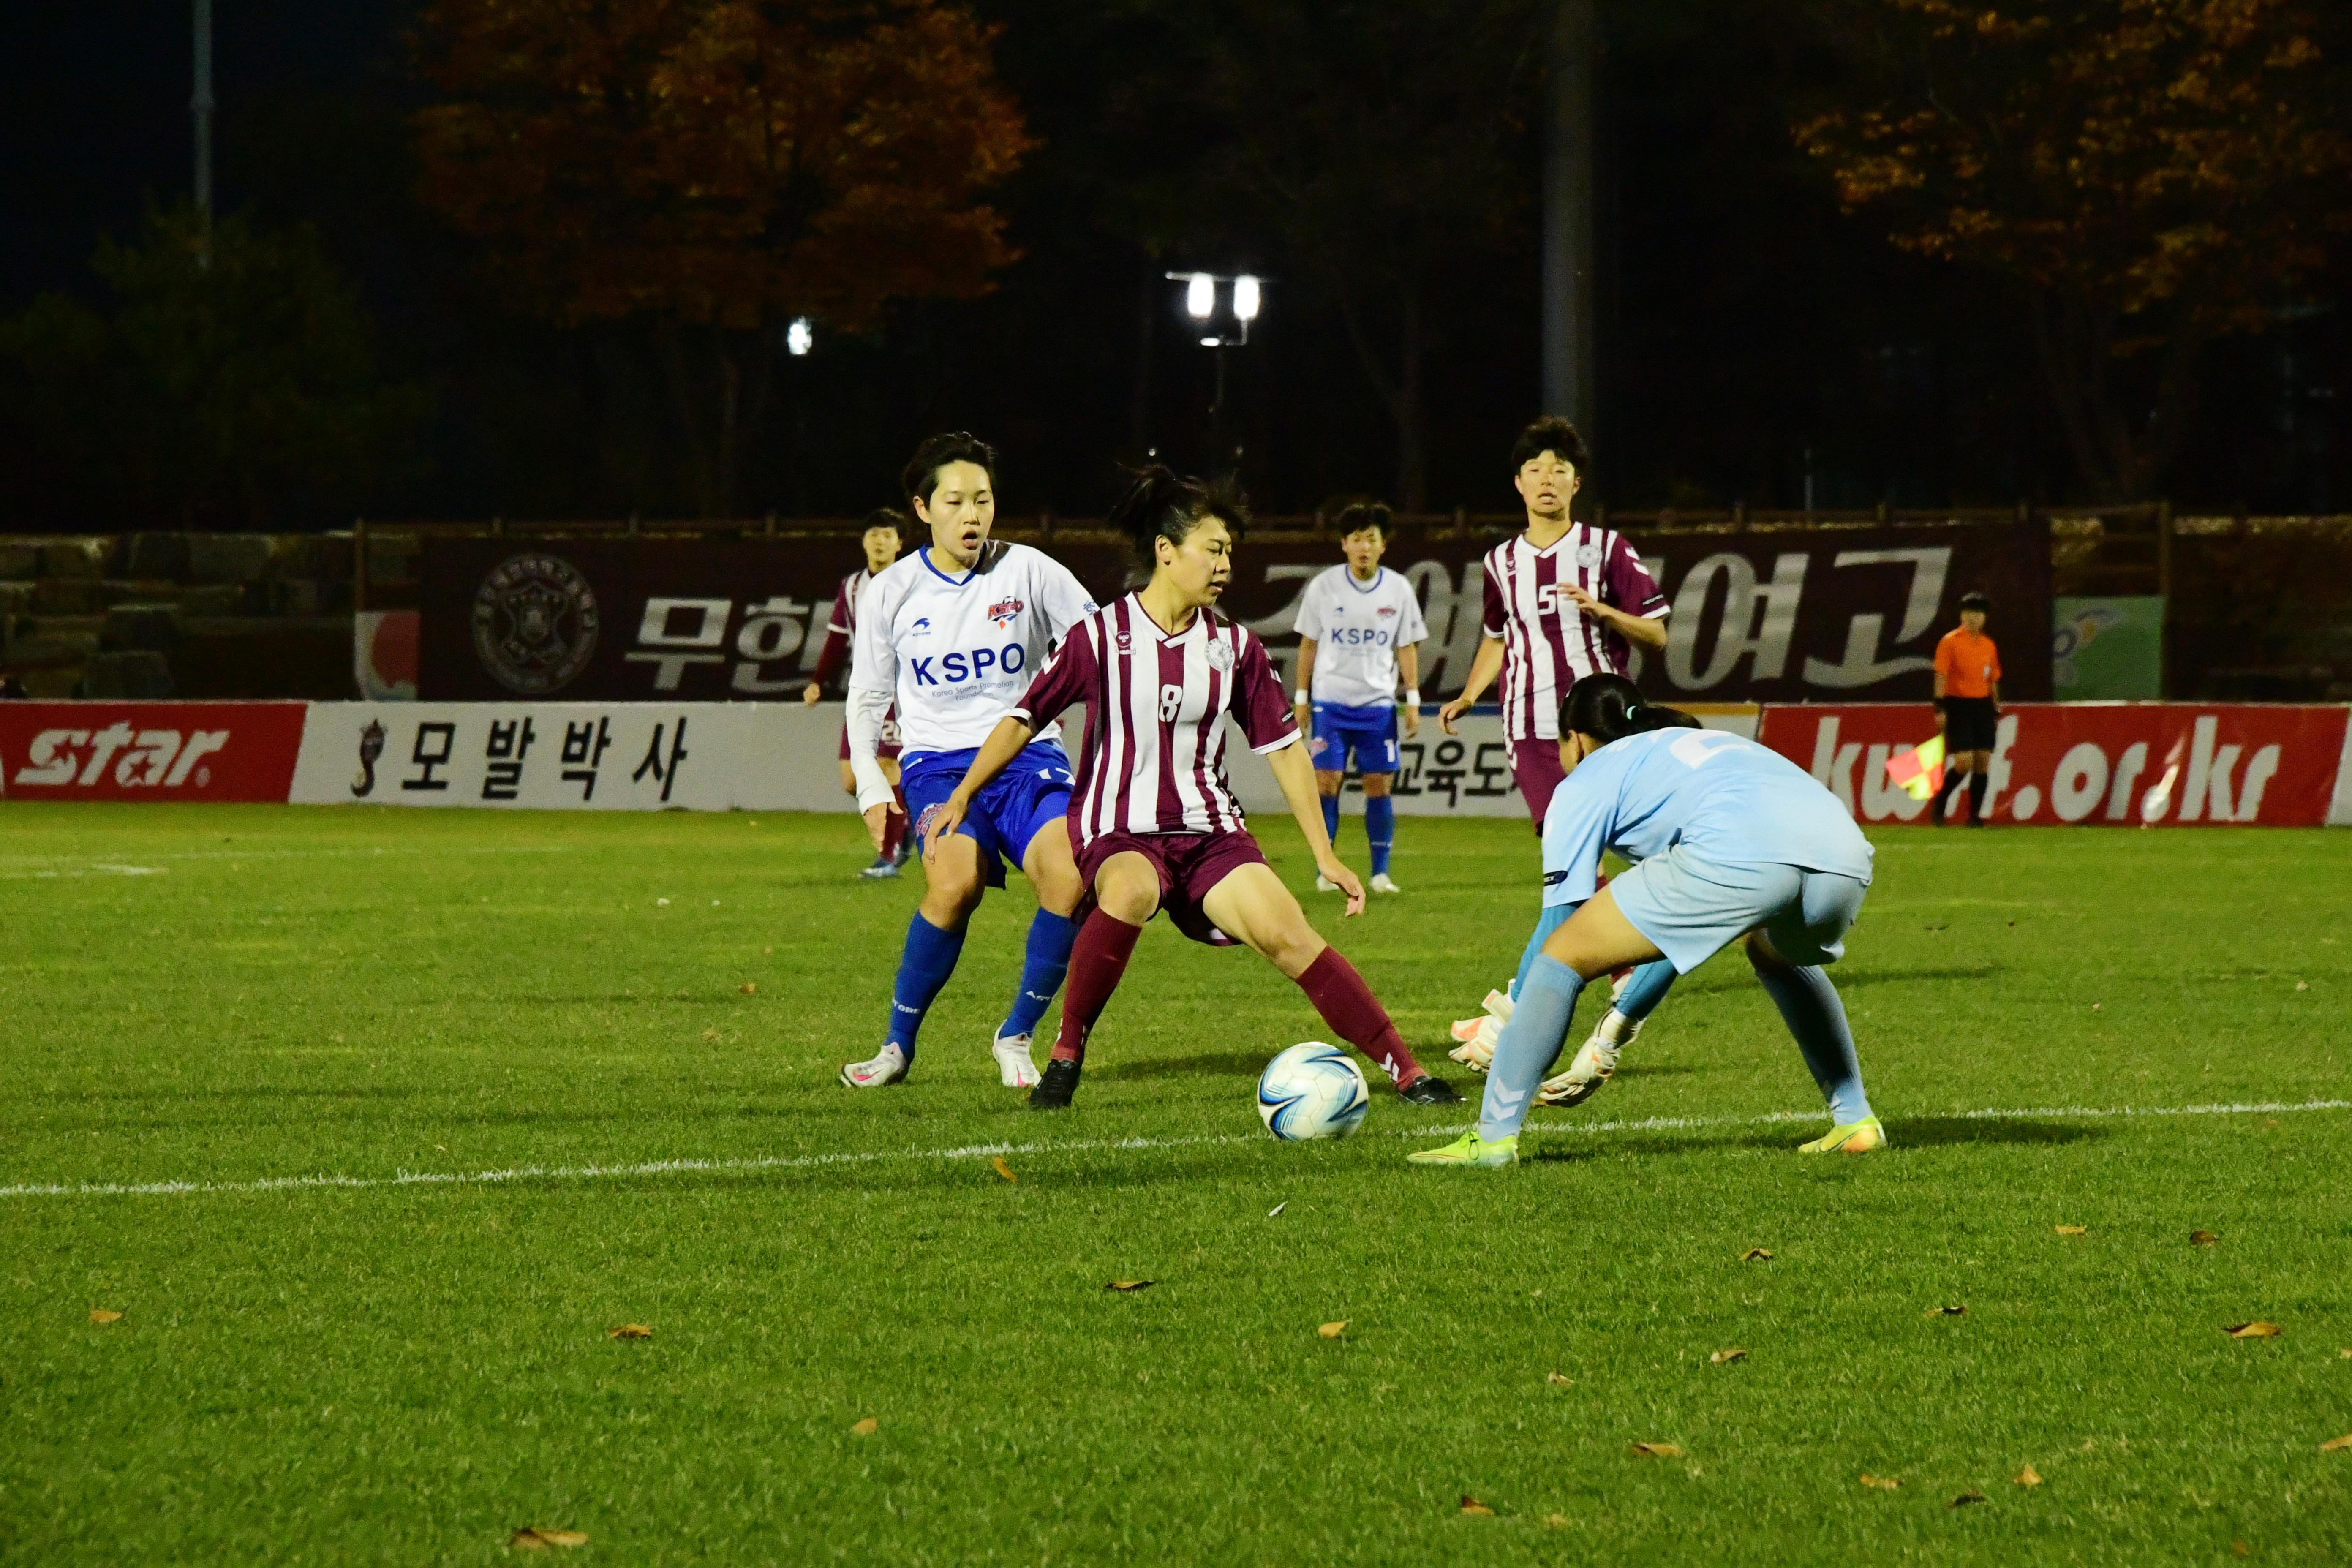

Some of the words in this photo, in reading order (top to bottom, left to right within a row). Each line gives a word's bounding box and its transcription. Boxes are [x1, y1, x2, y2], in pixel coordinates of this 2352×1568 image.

[1538, 583, 1557, 615] 5
[1332, 628, 1388, 646] KSPO
[911, 643, 1025, 686] KSPO
[956, 685, 977, 694] Sports
[980, 681, 1013, 690] Promotion
[1159, 684, 1183, 723] 8
[14, 720, 230, 787] star
[401, 716, 688, 801] 모발박사
